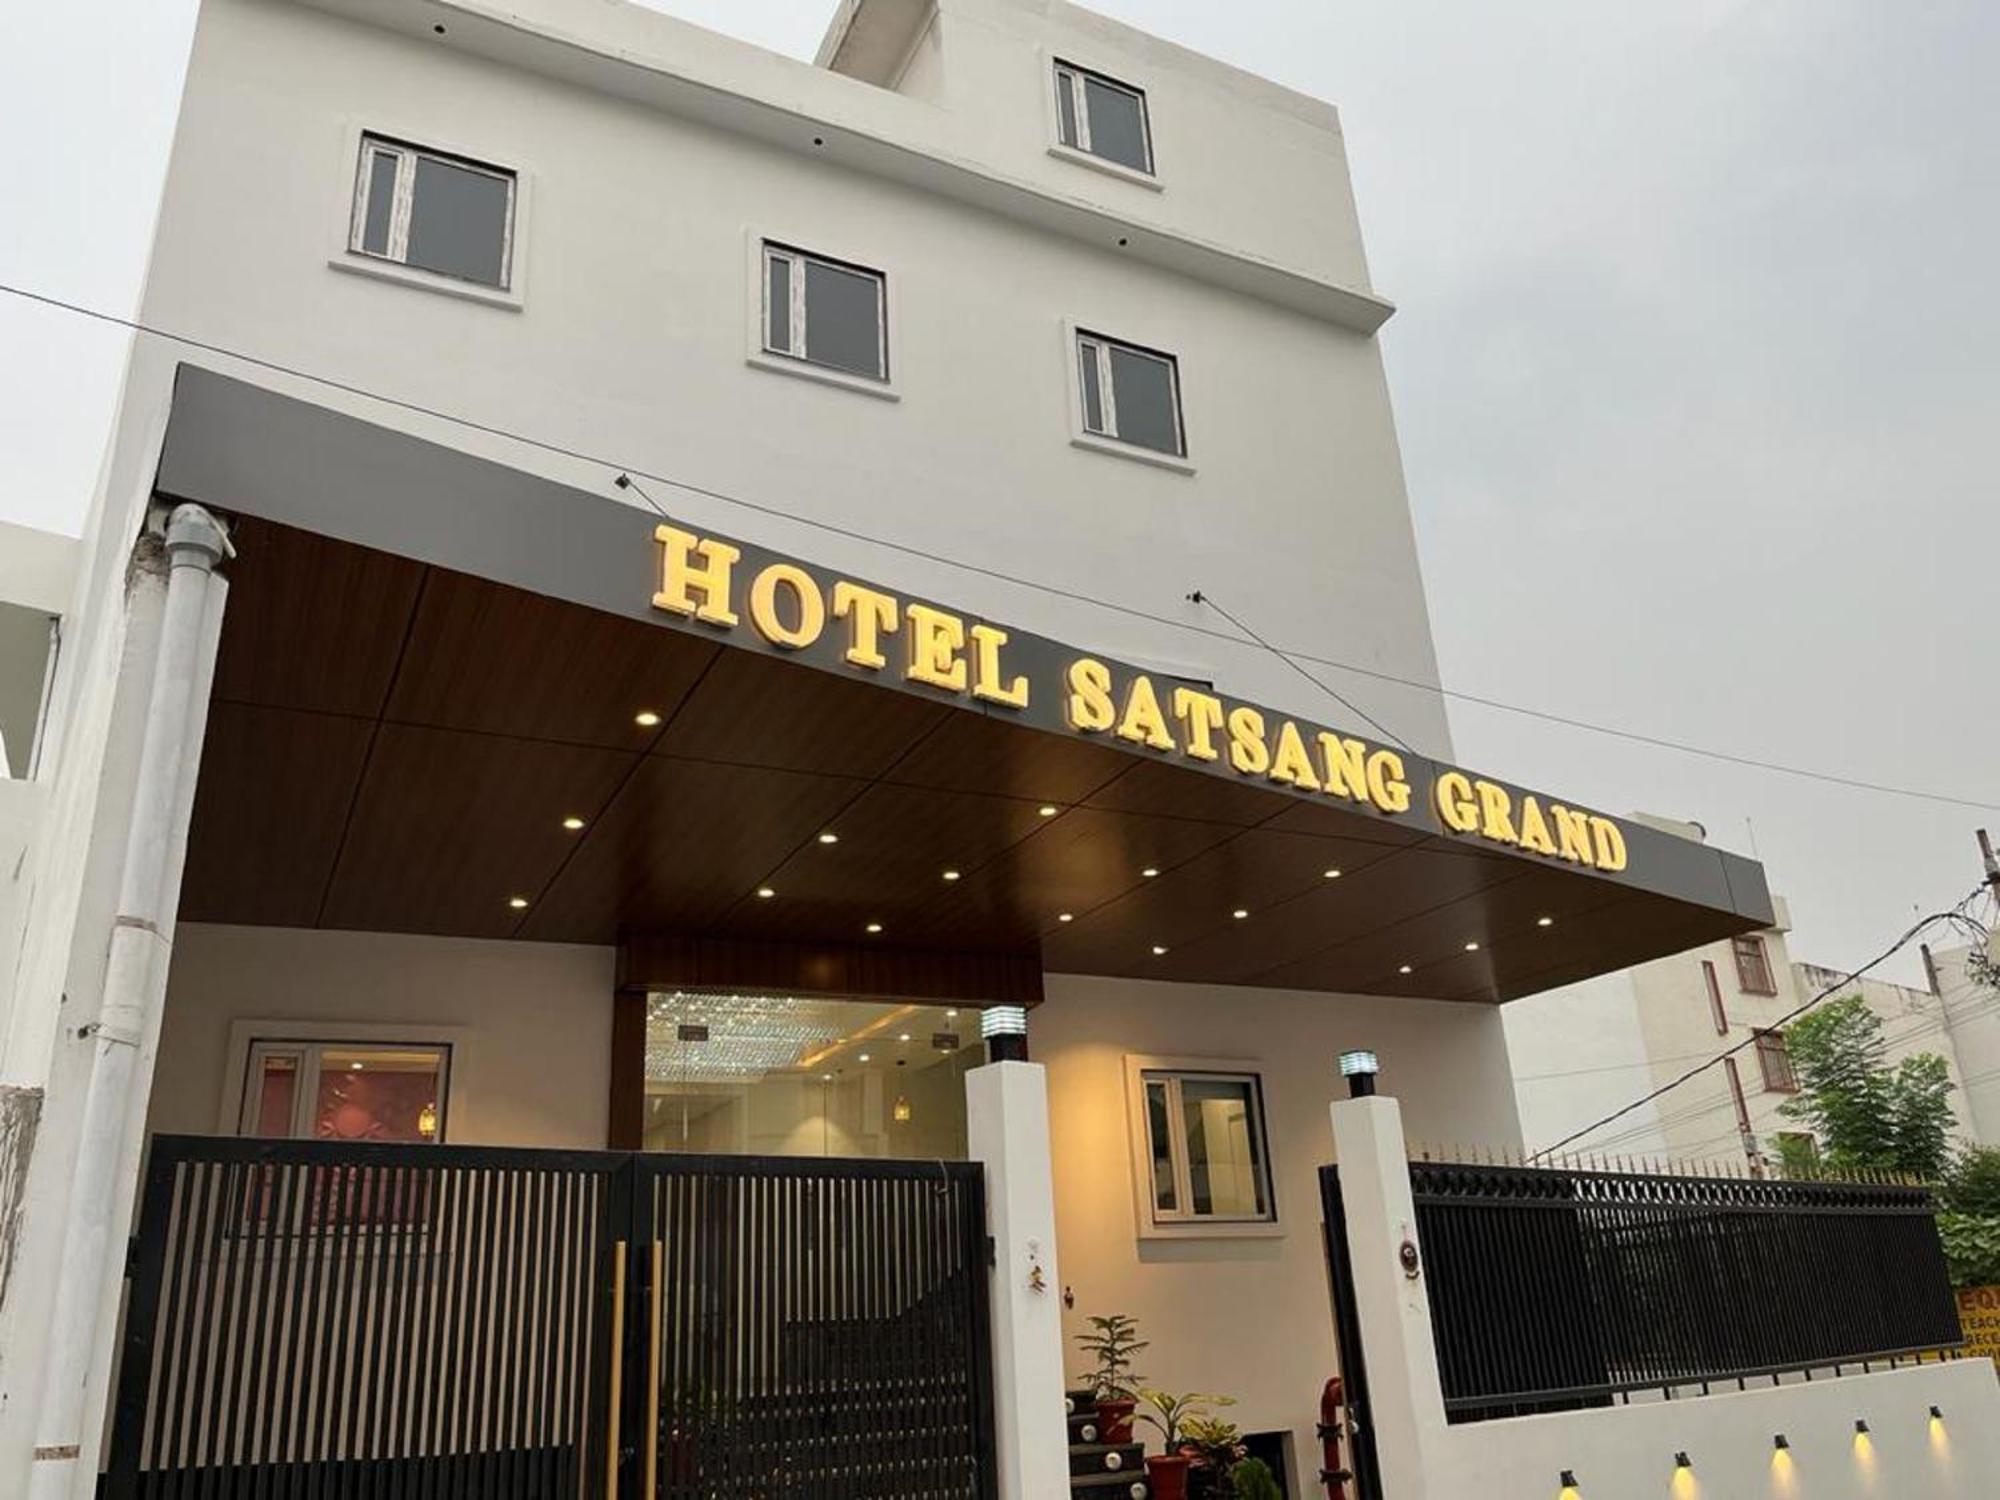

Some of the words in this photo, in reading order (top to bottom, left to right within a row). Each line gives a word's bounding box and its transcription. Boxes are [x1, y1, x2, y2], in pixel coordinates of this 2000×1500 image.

[653, 525, 1029, 709] HOTEL
[1068, 658, 1411, 814] SATSANG
[1436, 771, 1627, 872] GRAND
